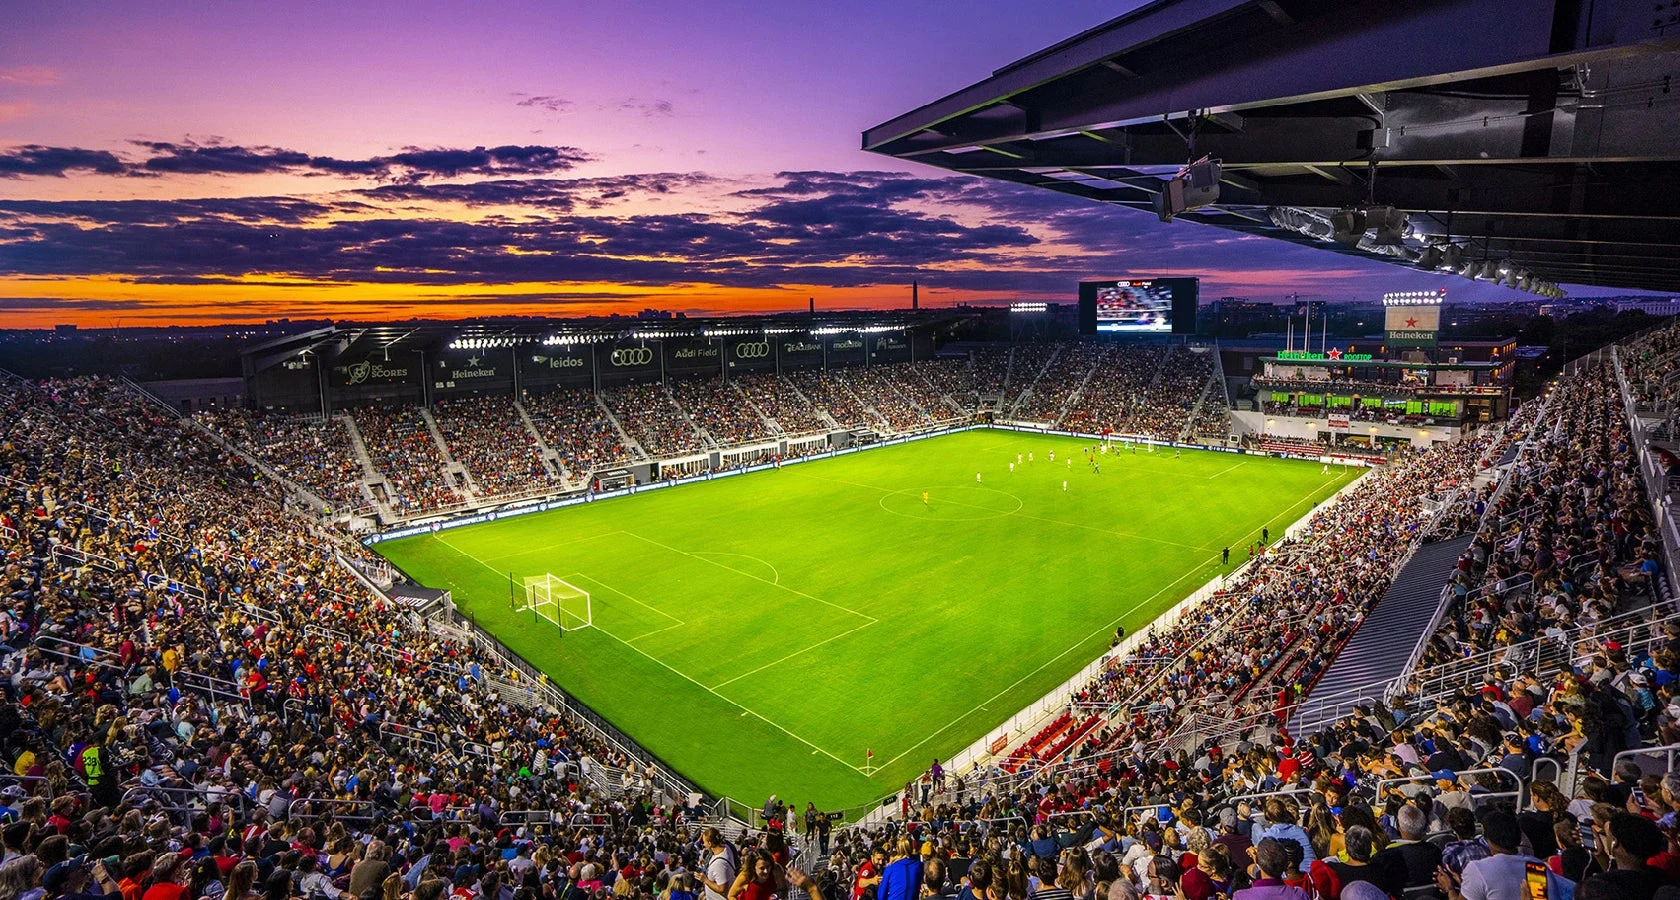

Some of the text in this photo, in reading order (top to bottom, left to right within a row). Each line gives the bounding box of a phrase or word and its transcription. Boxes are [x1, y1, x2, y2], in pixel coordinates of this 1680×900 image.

[1389, 331, 1433, 339] Heineken
[675, 348, 718, 358] Audi Field
[1277, 350, 1325, 360] Heineken
[550, 356, 584, 368] leidos
[371, 368, 408, 378] SCORES
[452, 368, 496, 379] Heineken
